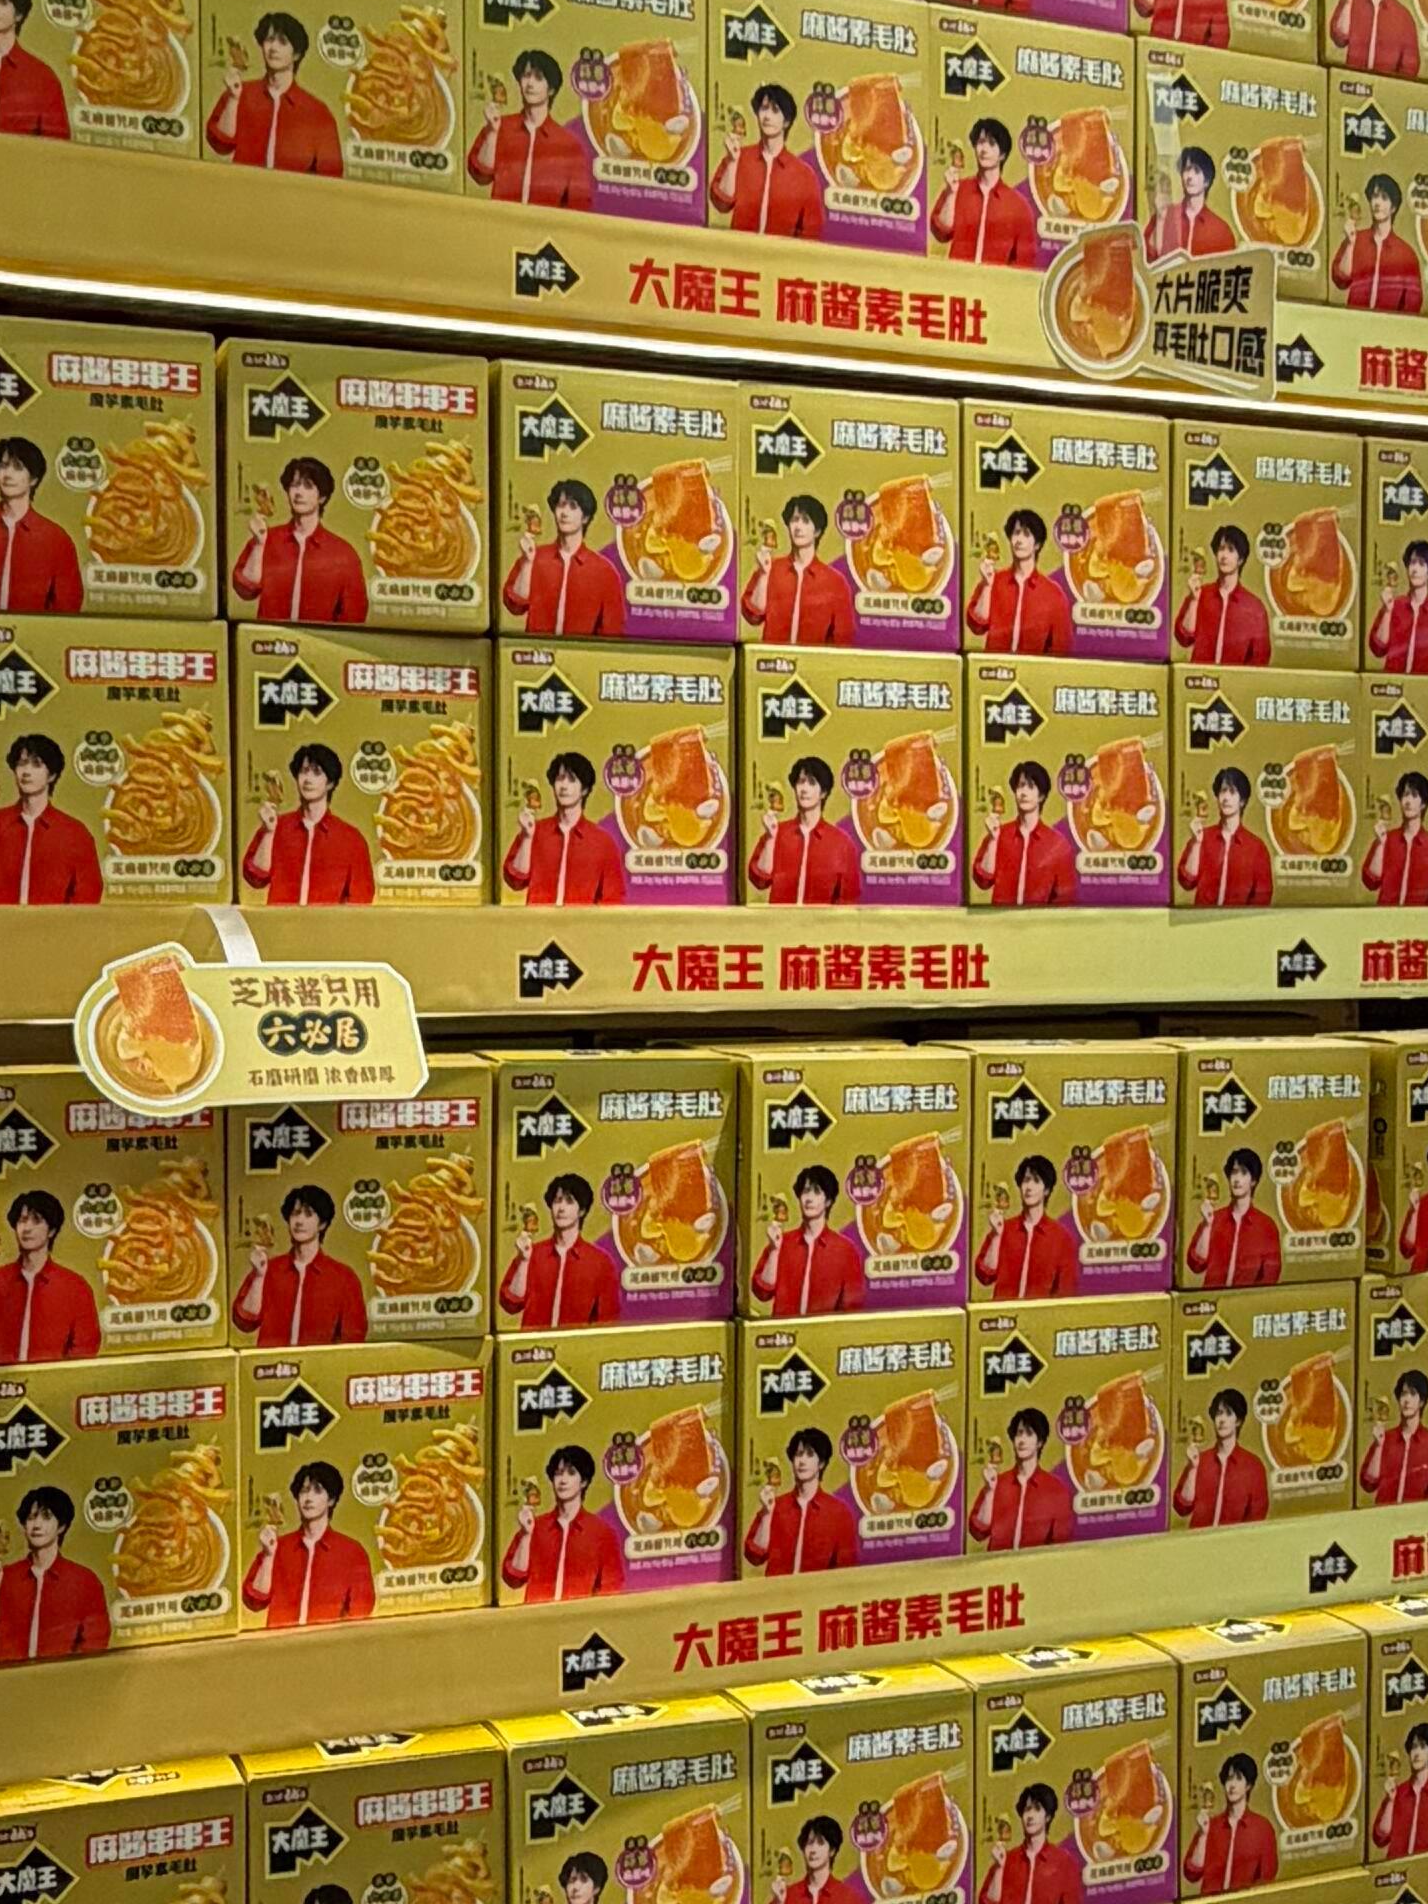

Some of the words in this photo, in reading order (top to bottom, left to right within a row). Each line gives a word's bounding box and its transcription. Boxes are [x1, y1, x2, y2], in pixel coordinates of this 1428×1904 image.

[517, 251, 567, 285] 大魔王
[628, 258, 760, 318] 大魔王
[776, 277, 988, 344] 麻酱素毛肚
[1154, 267, 1253, 315] 大片脆爽
[1154, 322, 1267, 377] 真毛肚口感
[522, 959, 570, 981] 大魔王
[632, 944, 763, 992] 大魔王
[779, 943, 990, 990] 麻酱素毛肚
[229, 976, 380, 1009] 芝麻酱只用
[262, 1016, 360, 1048] 六必居
[79, 1388, 223, 1424] 麻酱串串王
[521, 1387, 575, 1411] 大魔王
[601, 1355, 725, 1388] 麻酱素毛肚
[564, 1649, 611, 1674] 大魔王
[673, 1611, 802, 1673] 大魔王
[818, 1584, 1025, 1652] 麻酱素毛肚
[89, 1819, 231, 1864] 麻酱串串王
